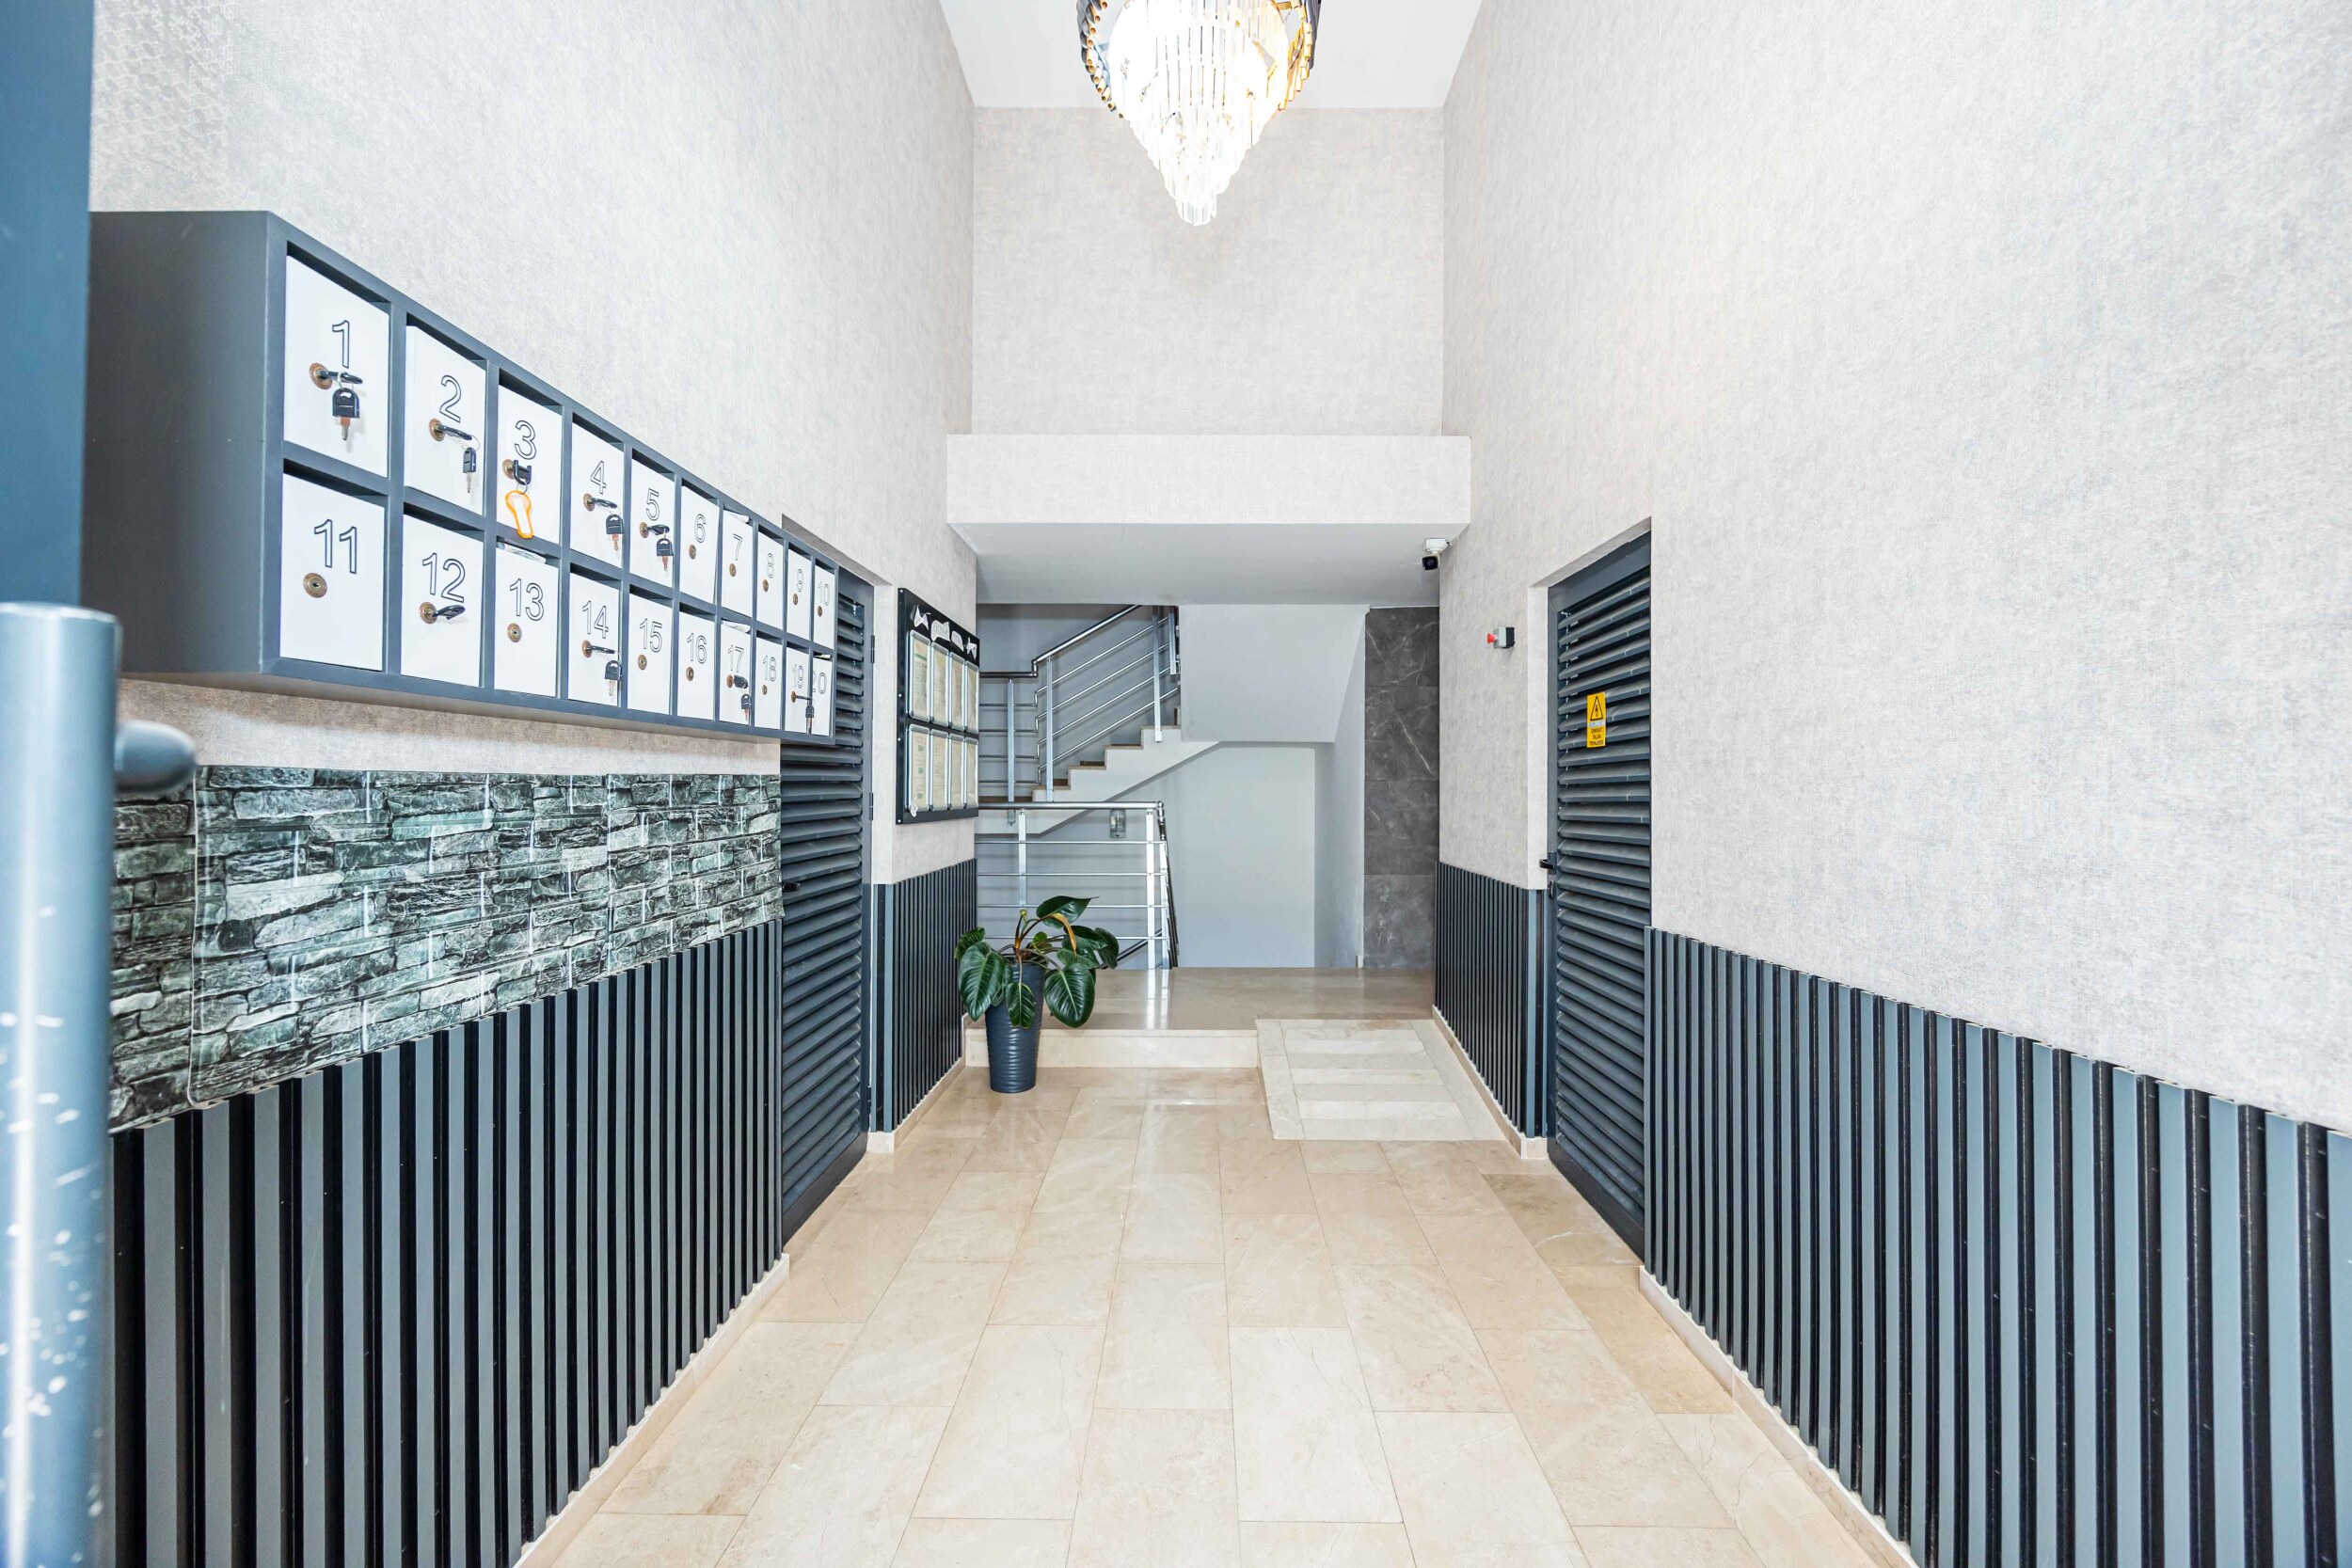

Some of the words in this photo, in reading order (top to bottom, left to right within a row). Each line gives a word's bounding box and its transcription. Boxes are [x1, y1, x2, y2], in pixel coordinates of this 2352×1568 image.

[331, 320, 351, 369] 1
[438, 374, 462, 423] 2
[514, 420, 536, 460] 3
[590, 460, 607, 495] 4
[645, 488, 660, 521] 5
[694, 514, 706, 544] 6
[313, 518, 358, 575] 11
[733, 533, 742, 562] 7
[421, 552, 466, 603] 12
[767, 552, 774, 579] 8
[796, 568, 803, 594] 9
[509, 578, 544, 622] 13
[818, 581, 830, 607] 10
[581, 600, 609, 640] 14
[640, 617, 662, 653] 15
[687, 632, 707, 665] 16
[727, 643, 744, 673] 17
[763, 655, 776, 682] 18
[792, 663, 803, 689] 19
